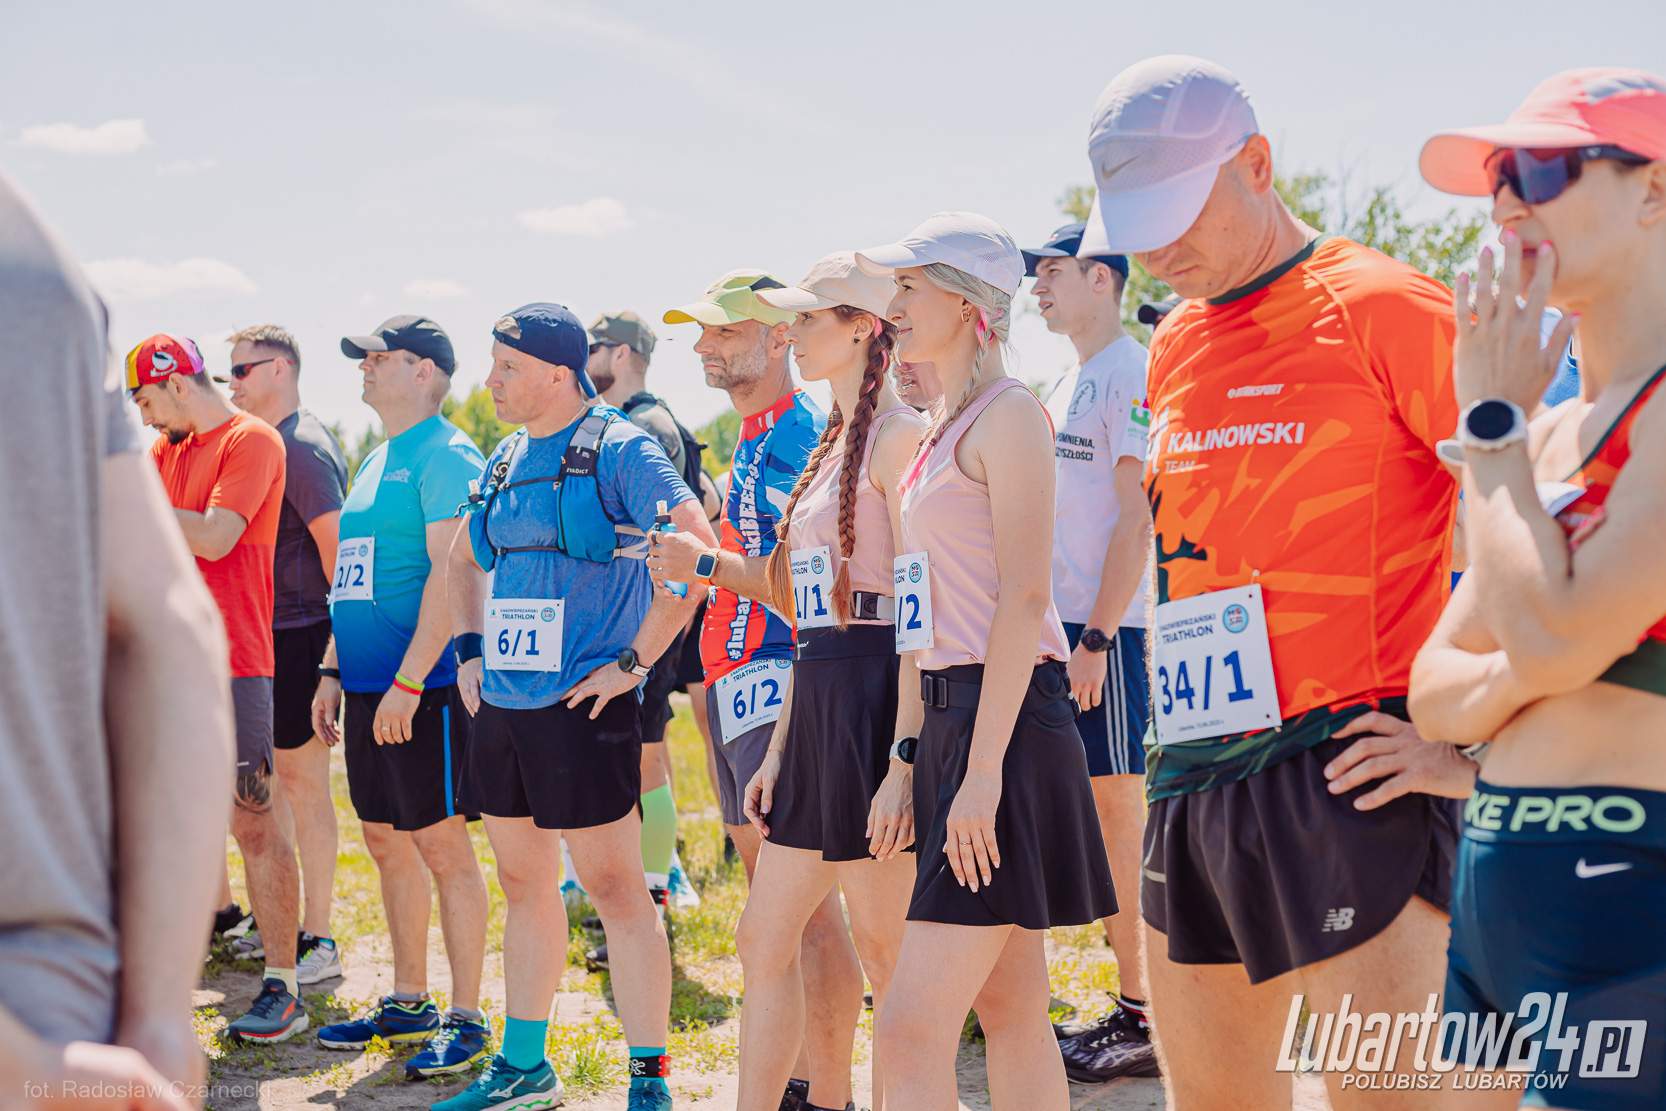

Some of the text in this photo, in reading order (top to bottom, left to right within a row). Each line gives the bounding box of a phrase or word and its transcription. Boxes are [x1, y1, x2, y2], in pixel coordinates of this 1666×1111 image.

[1167, 421, 1305, 454] KALINOWSKI
[1165, 460, 1196, 471] TEAM
[498, 629, 539, 656] 6/1
[1162, 624, 1214, 644] TRIATHLON
[733, 664, 769, 681] TRIATHLON
[1158, 650, 1254, 715] 34/1
[733, 679, 782, 719] 6/2
[1509, 795, 1647, 833] PRO
